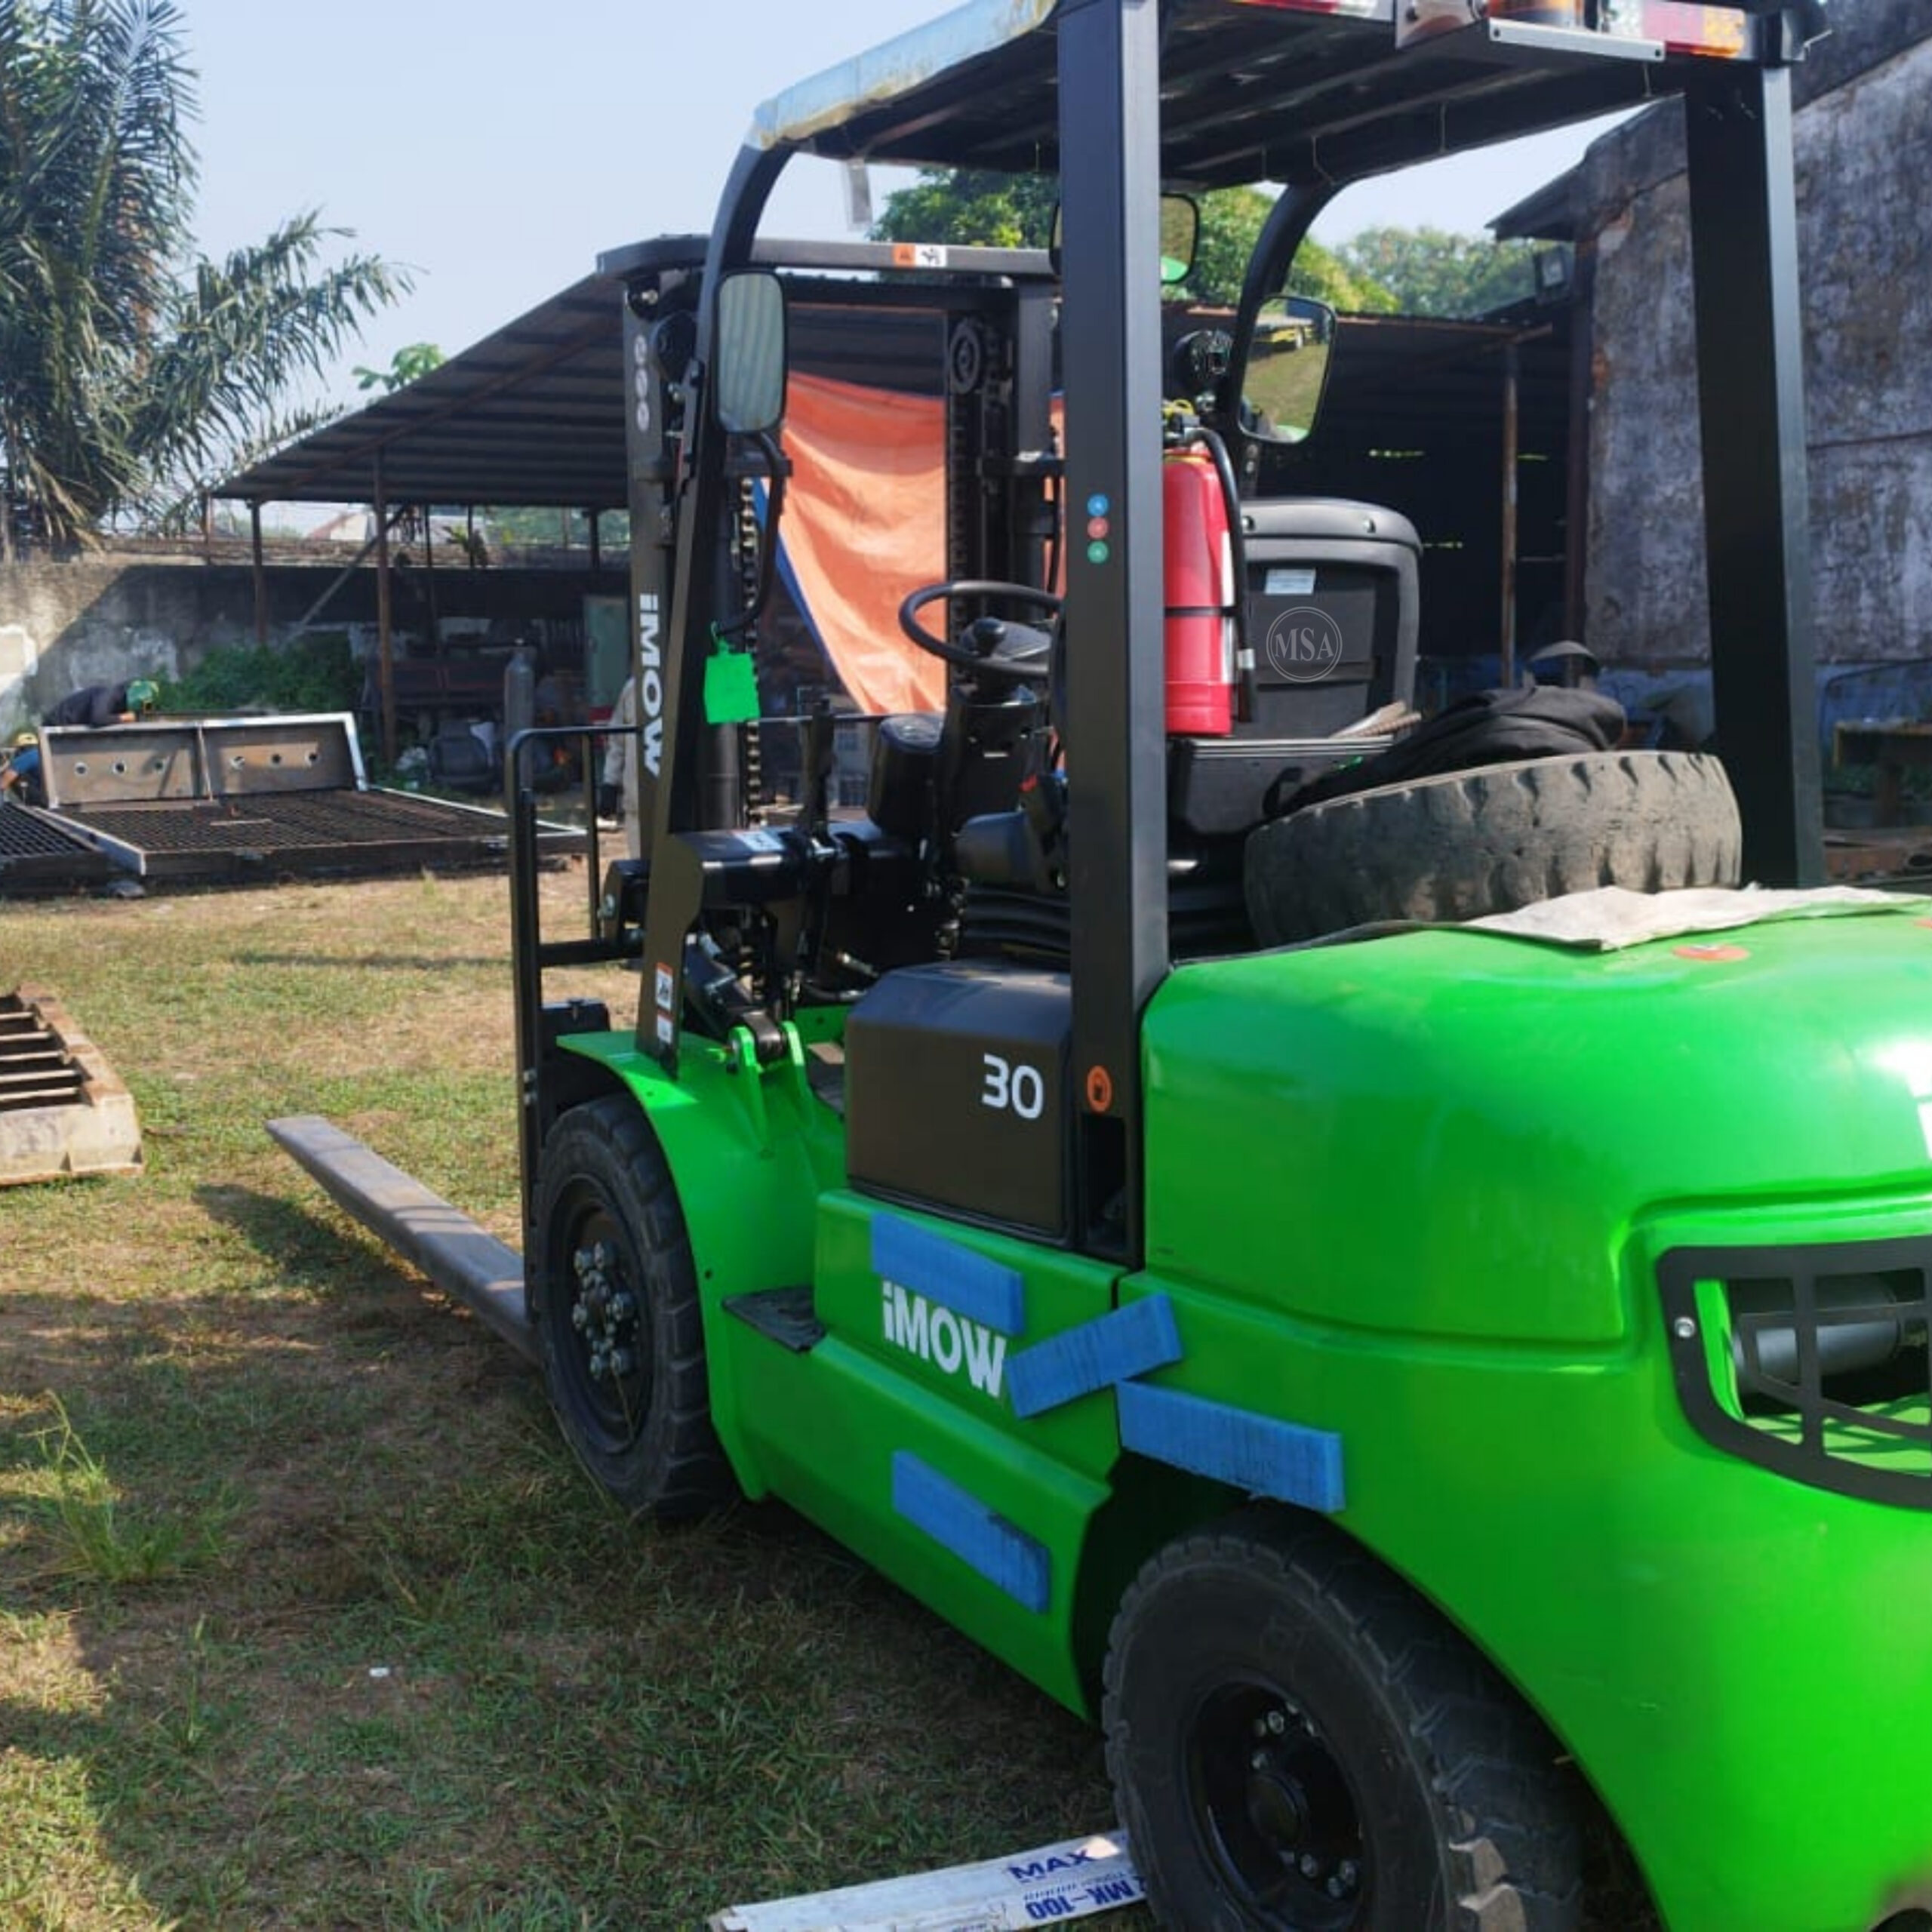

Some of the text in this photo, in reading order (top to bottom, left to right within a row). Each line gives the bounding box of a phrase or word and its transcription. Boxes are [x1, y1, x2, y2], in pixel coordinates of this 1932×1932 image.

[640, 594, 663, 777] iMOW
[982, 1053, 1044, 1118] 30
[882, 1280, 1007, 1398] iMOW
[1008, 1849, 1096, 1879] MAX
[1025, 1879, 1135, 1920] MK-100
